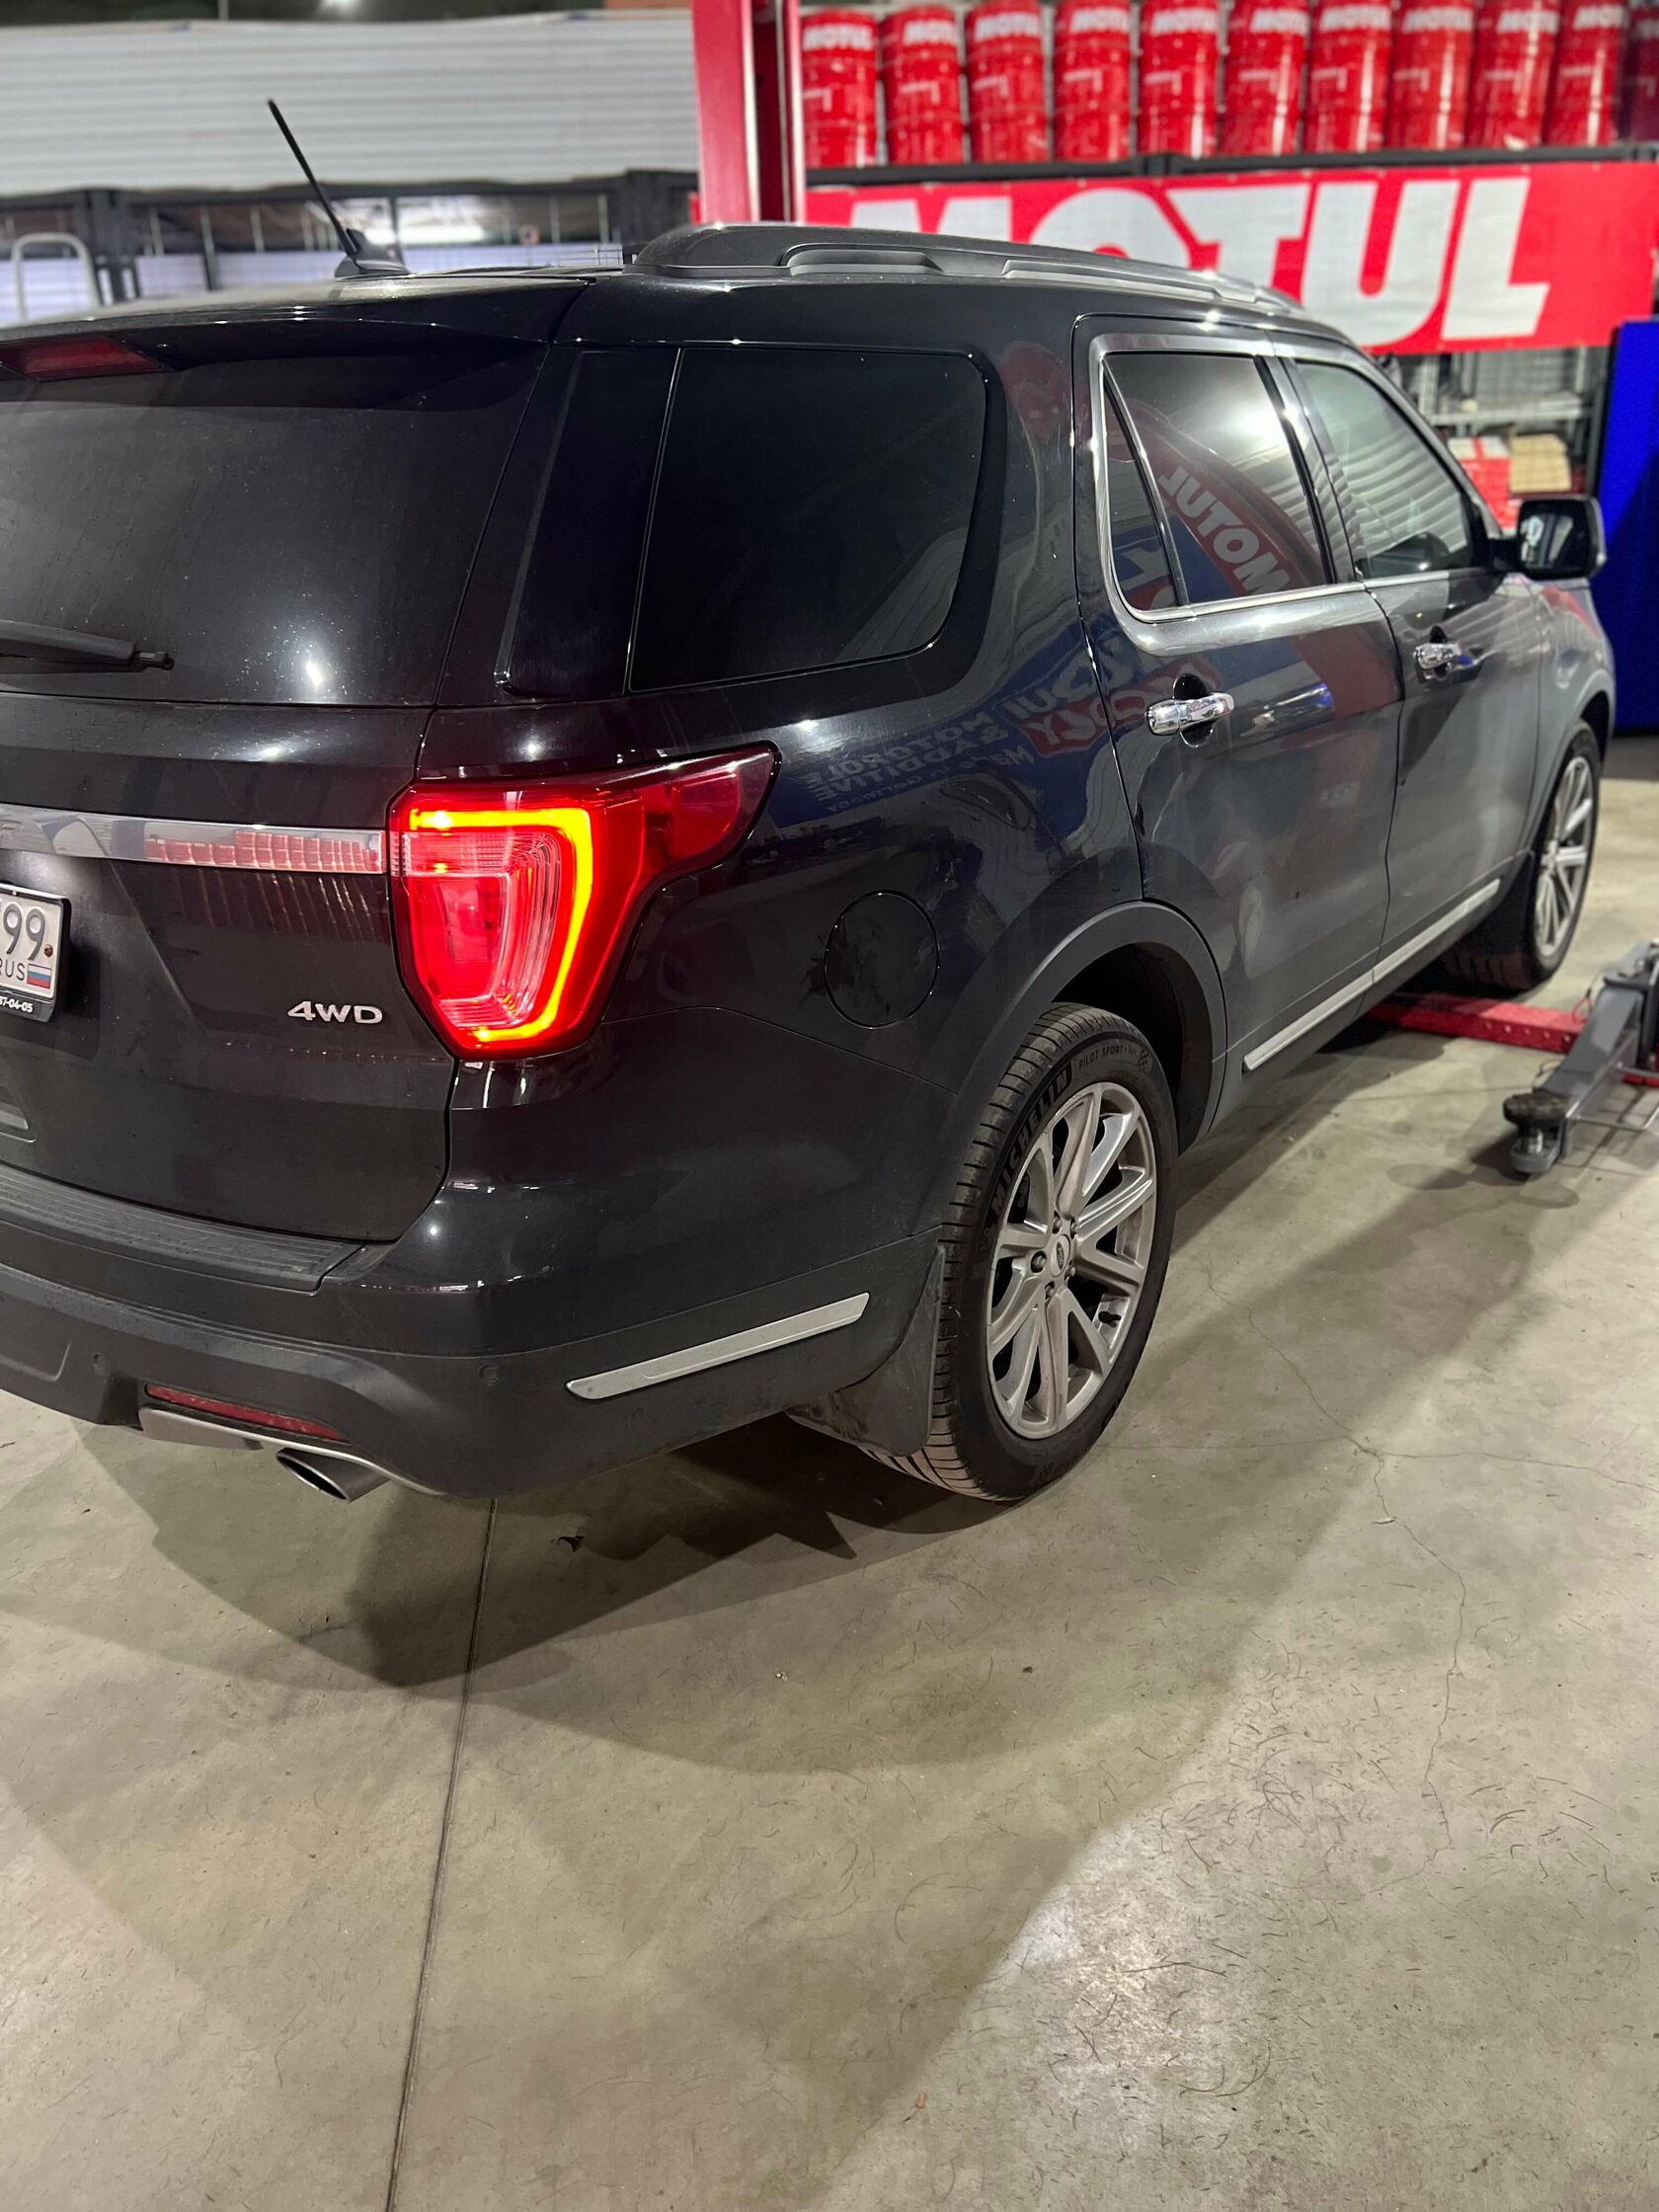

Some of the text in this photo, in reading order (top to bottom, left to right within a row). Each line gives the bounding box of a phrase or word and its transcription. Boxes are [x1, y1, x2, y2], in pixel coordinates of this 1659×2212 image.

[846, 177, 1550, 347] TUL
[287, 1000, 383, 1024] 4WD
[1078, 1049, 1099, 1070] PILOT
[990, 1068, 1069, 1216] MICHELIN
